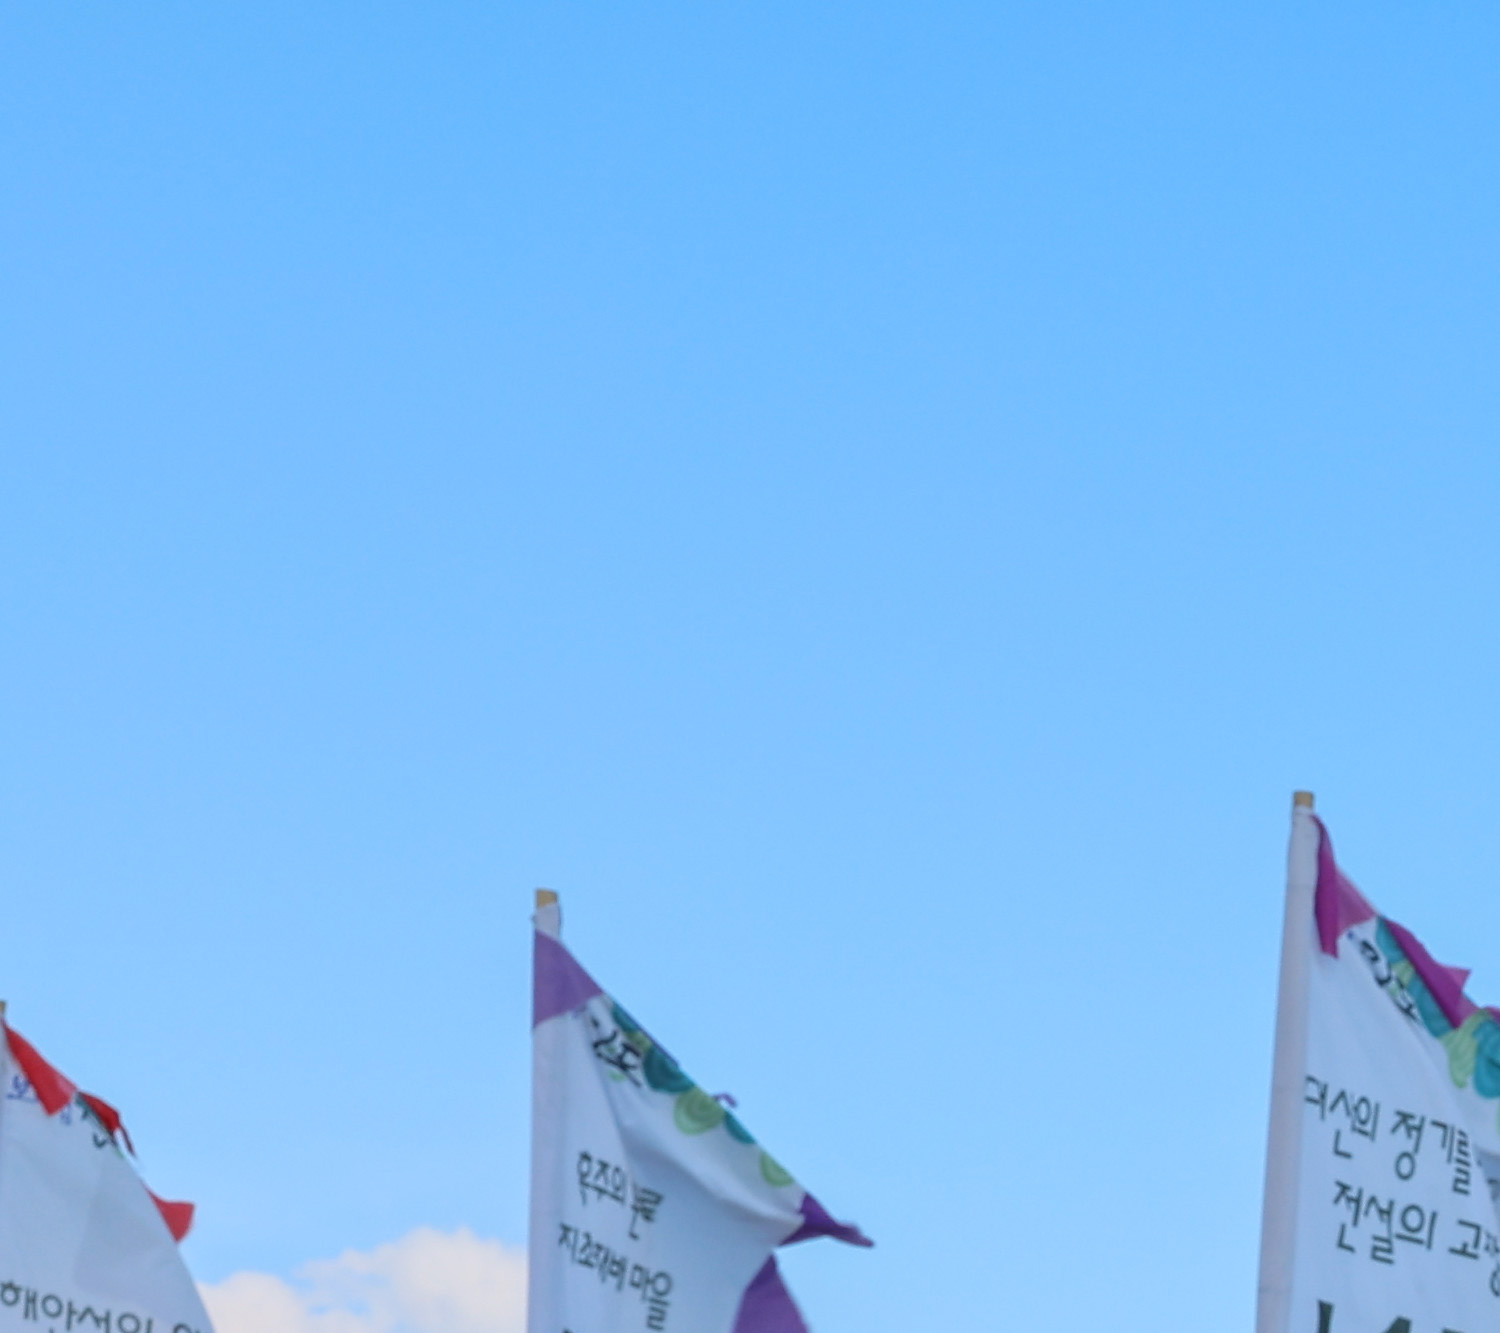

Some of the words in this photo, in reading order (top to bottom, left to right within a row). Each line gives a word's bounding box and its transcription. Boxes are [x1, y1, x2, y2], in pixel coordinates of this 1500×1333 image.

[1390, 1109, 1473, 1197] 정기를
[1332, 1179, 1439, 1267] 전설의
[629, 1262, 674, 1333] 마을
